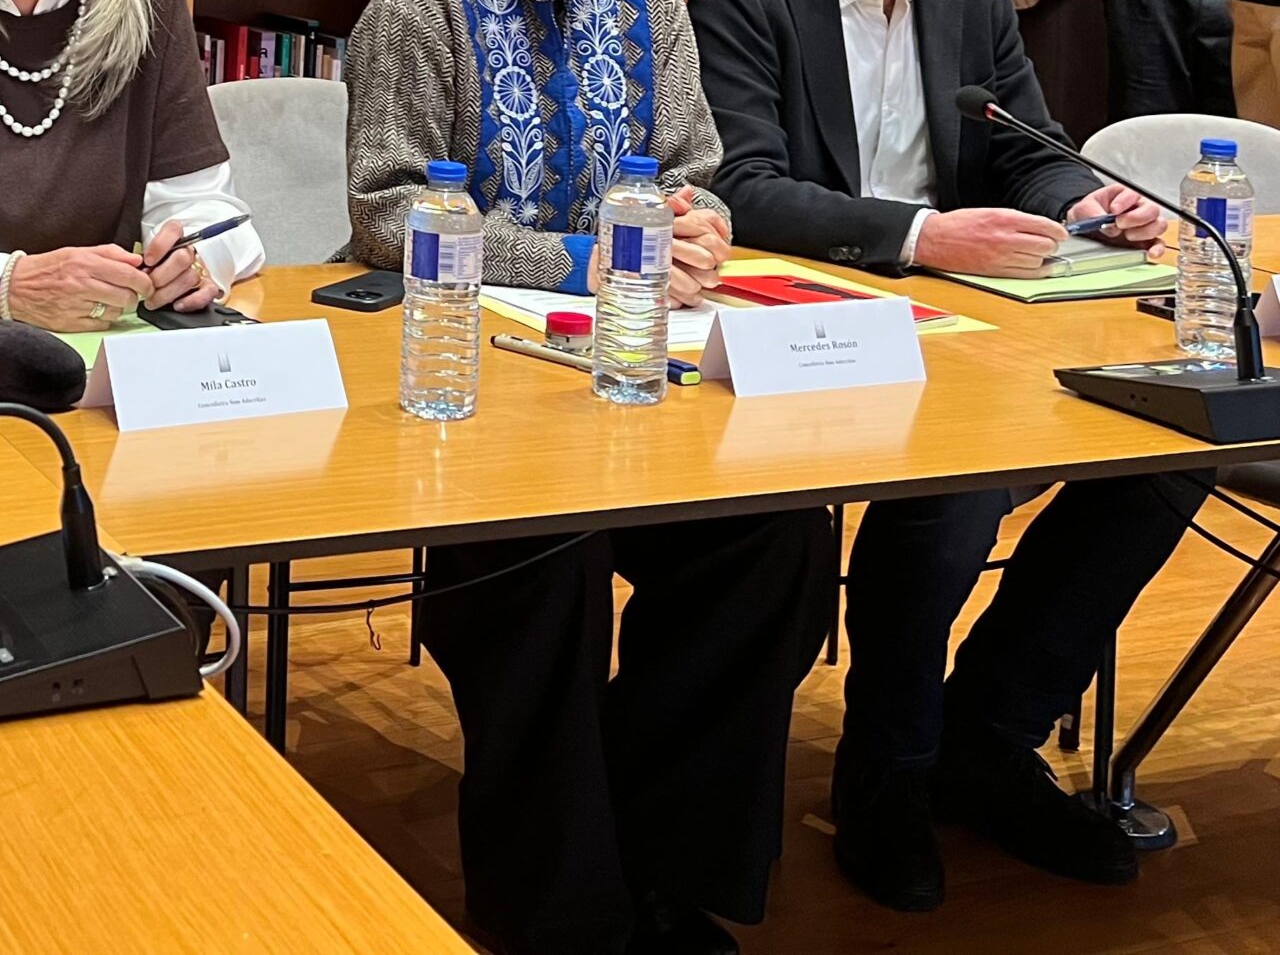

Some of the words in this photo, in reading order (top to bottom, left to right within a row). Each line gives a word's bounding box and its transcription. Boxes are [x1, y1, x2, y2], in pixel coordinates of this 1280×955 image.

[790, 341, 831, 352] Mercedes
[200, 380, 223, 391] Mila
[224, 379, 257, 389] Castro
